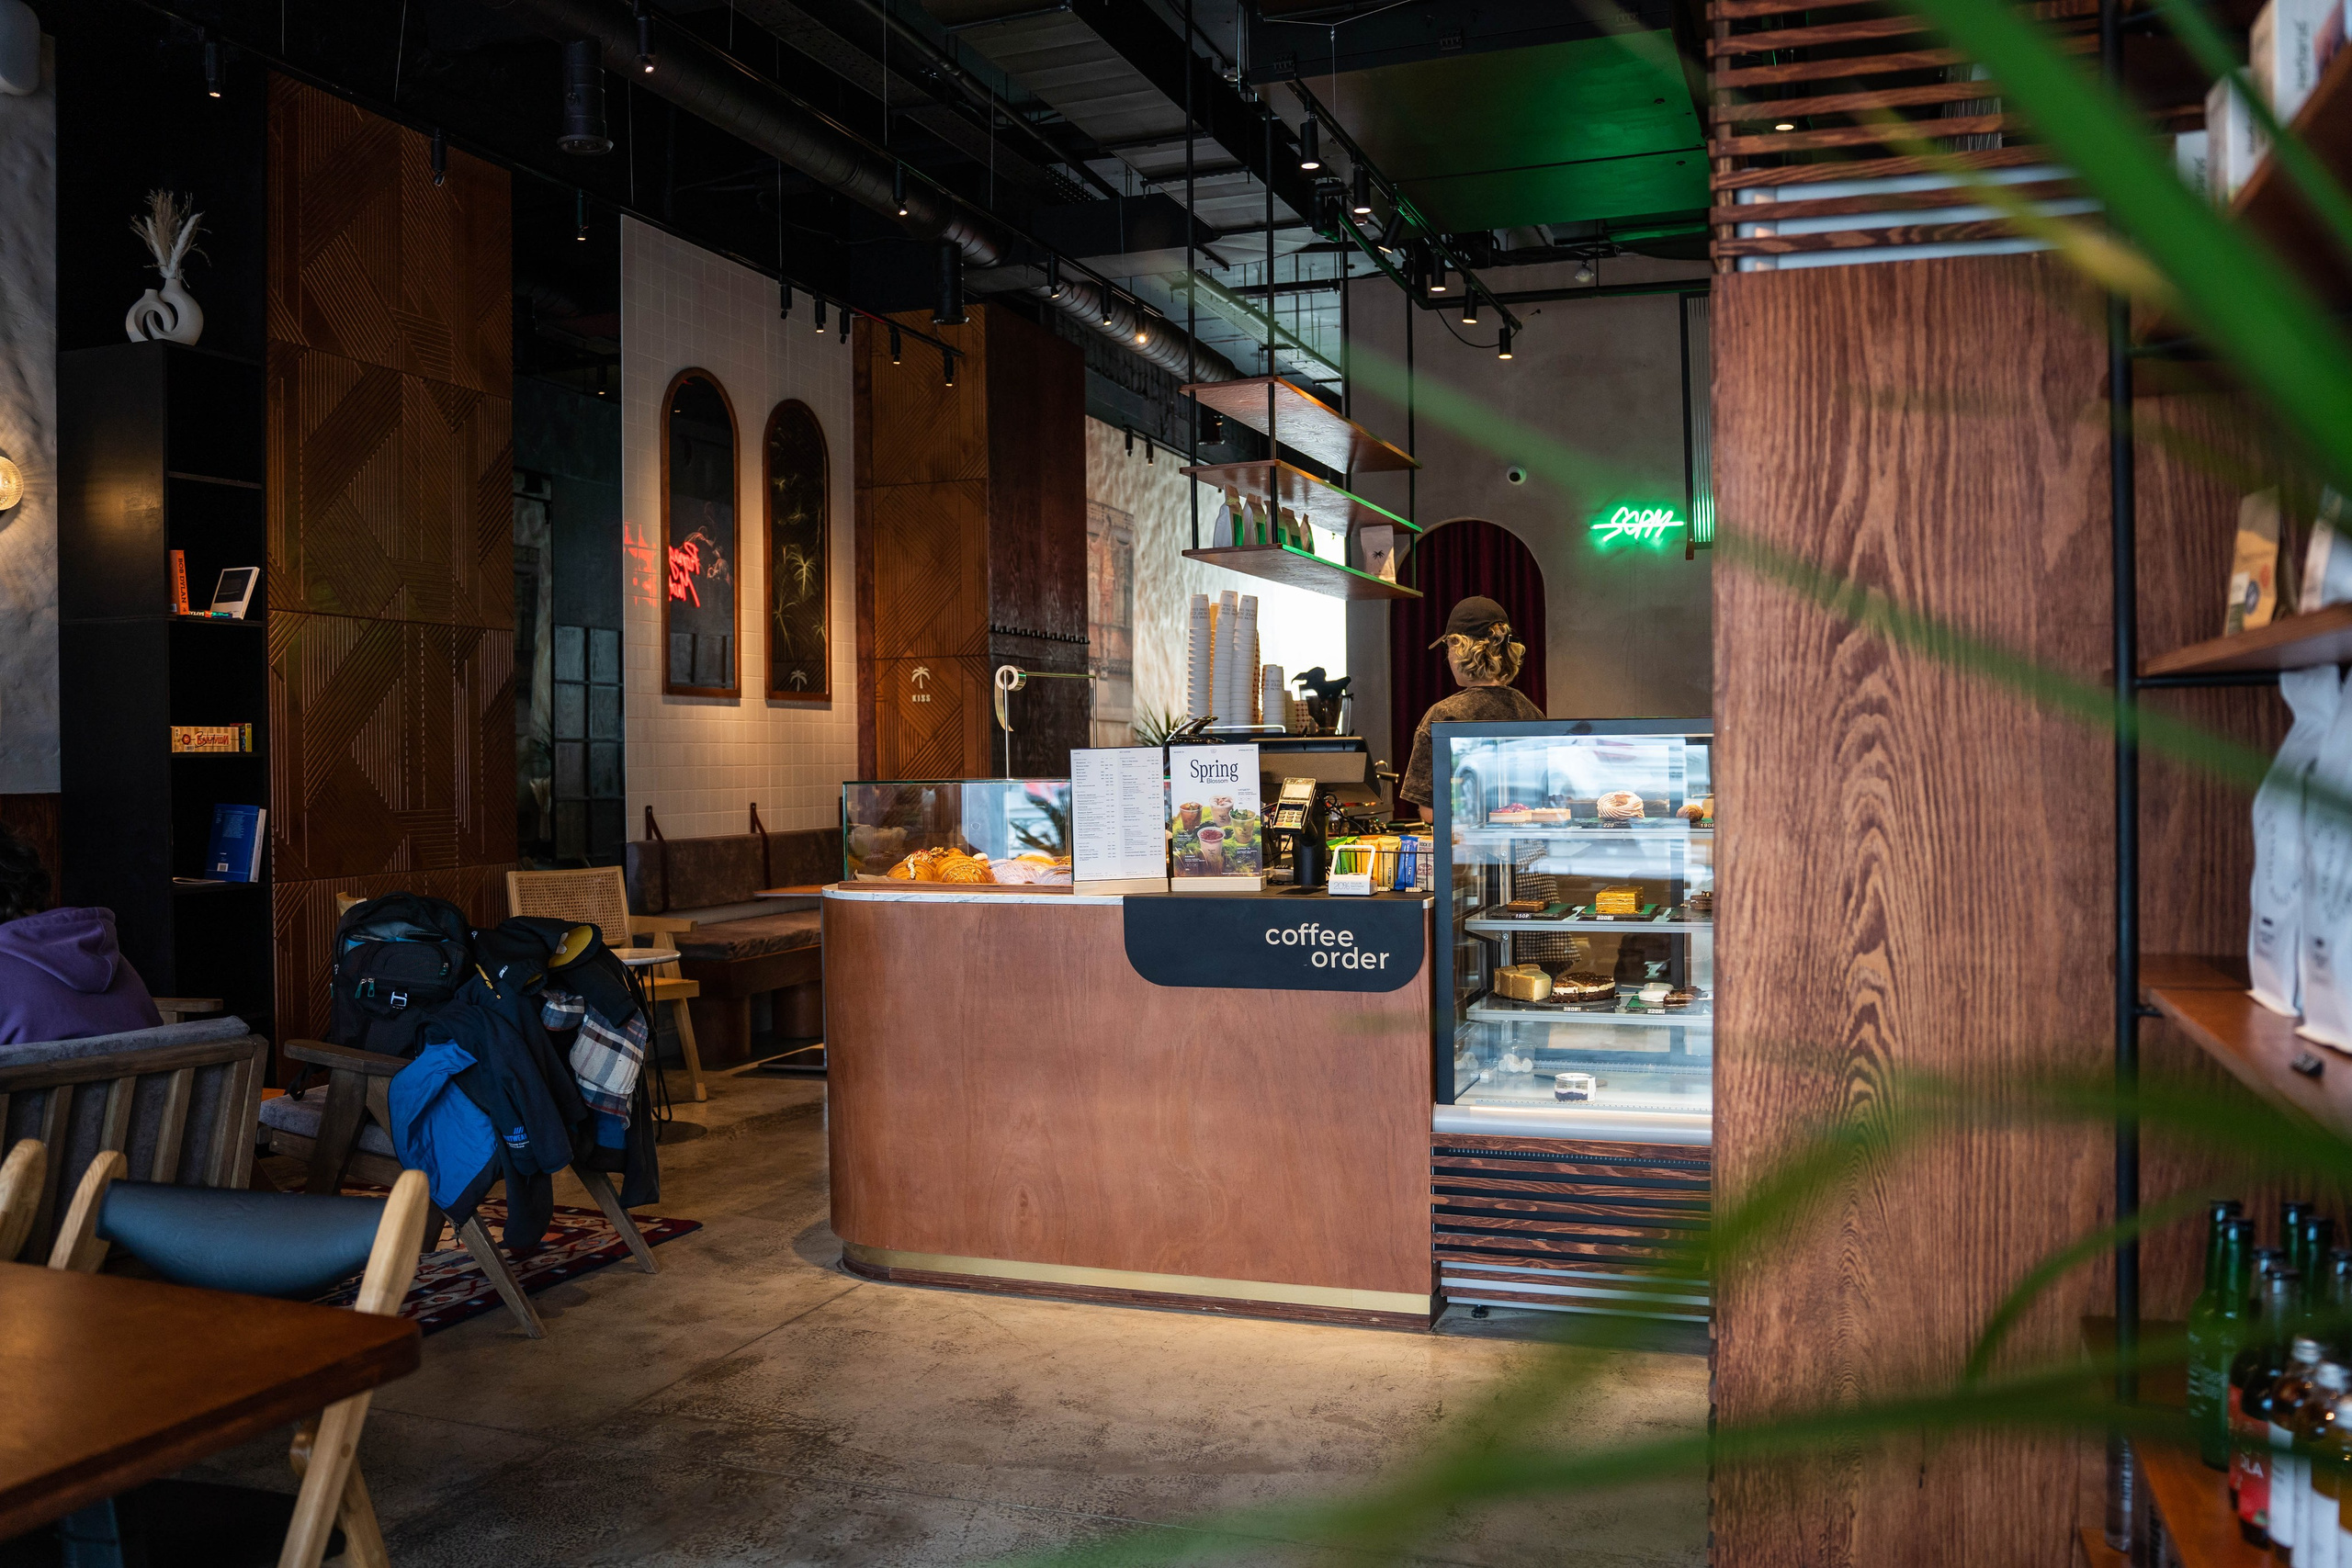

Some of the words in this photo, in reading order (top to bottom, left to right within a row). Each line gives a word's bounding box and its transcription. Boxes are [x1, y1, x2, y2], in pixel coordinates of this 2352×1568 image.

[179, 576, 187, 604] DYLAN
[911, 694, 931, 702] KISS
[1190, 759, 1239, 784] Spring
[1333, 881, 1351, 890] 20%
[1265, 922, 1354, 947] coffee
[1311, 947, 1390, 970] order
